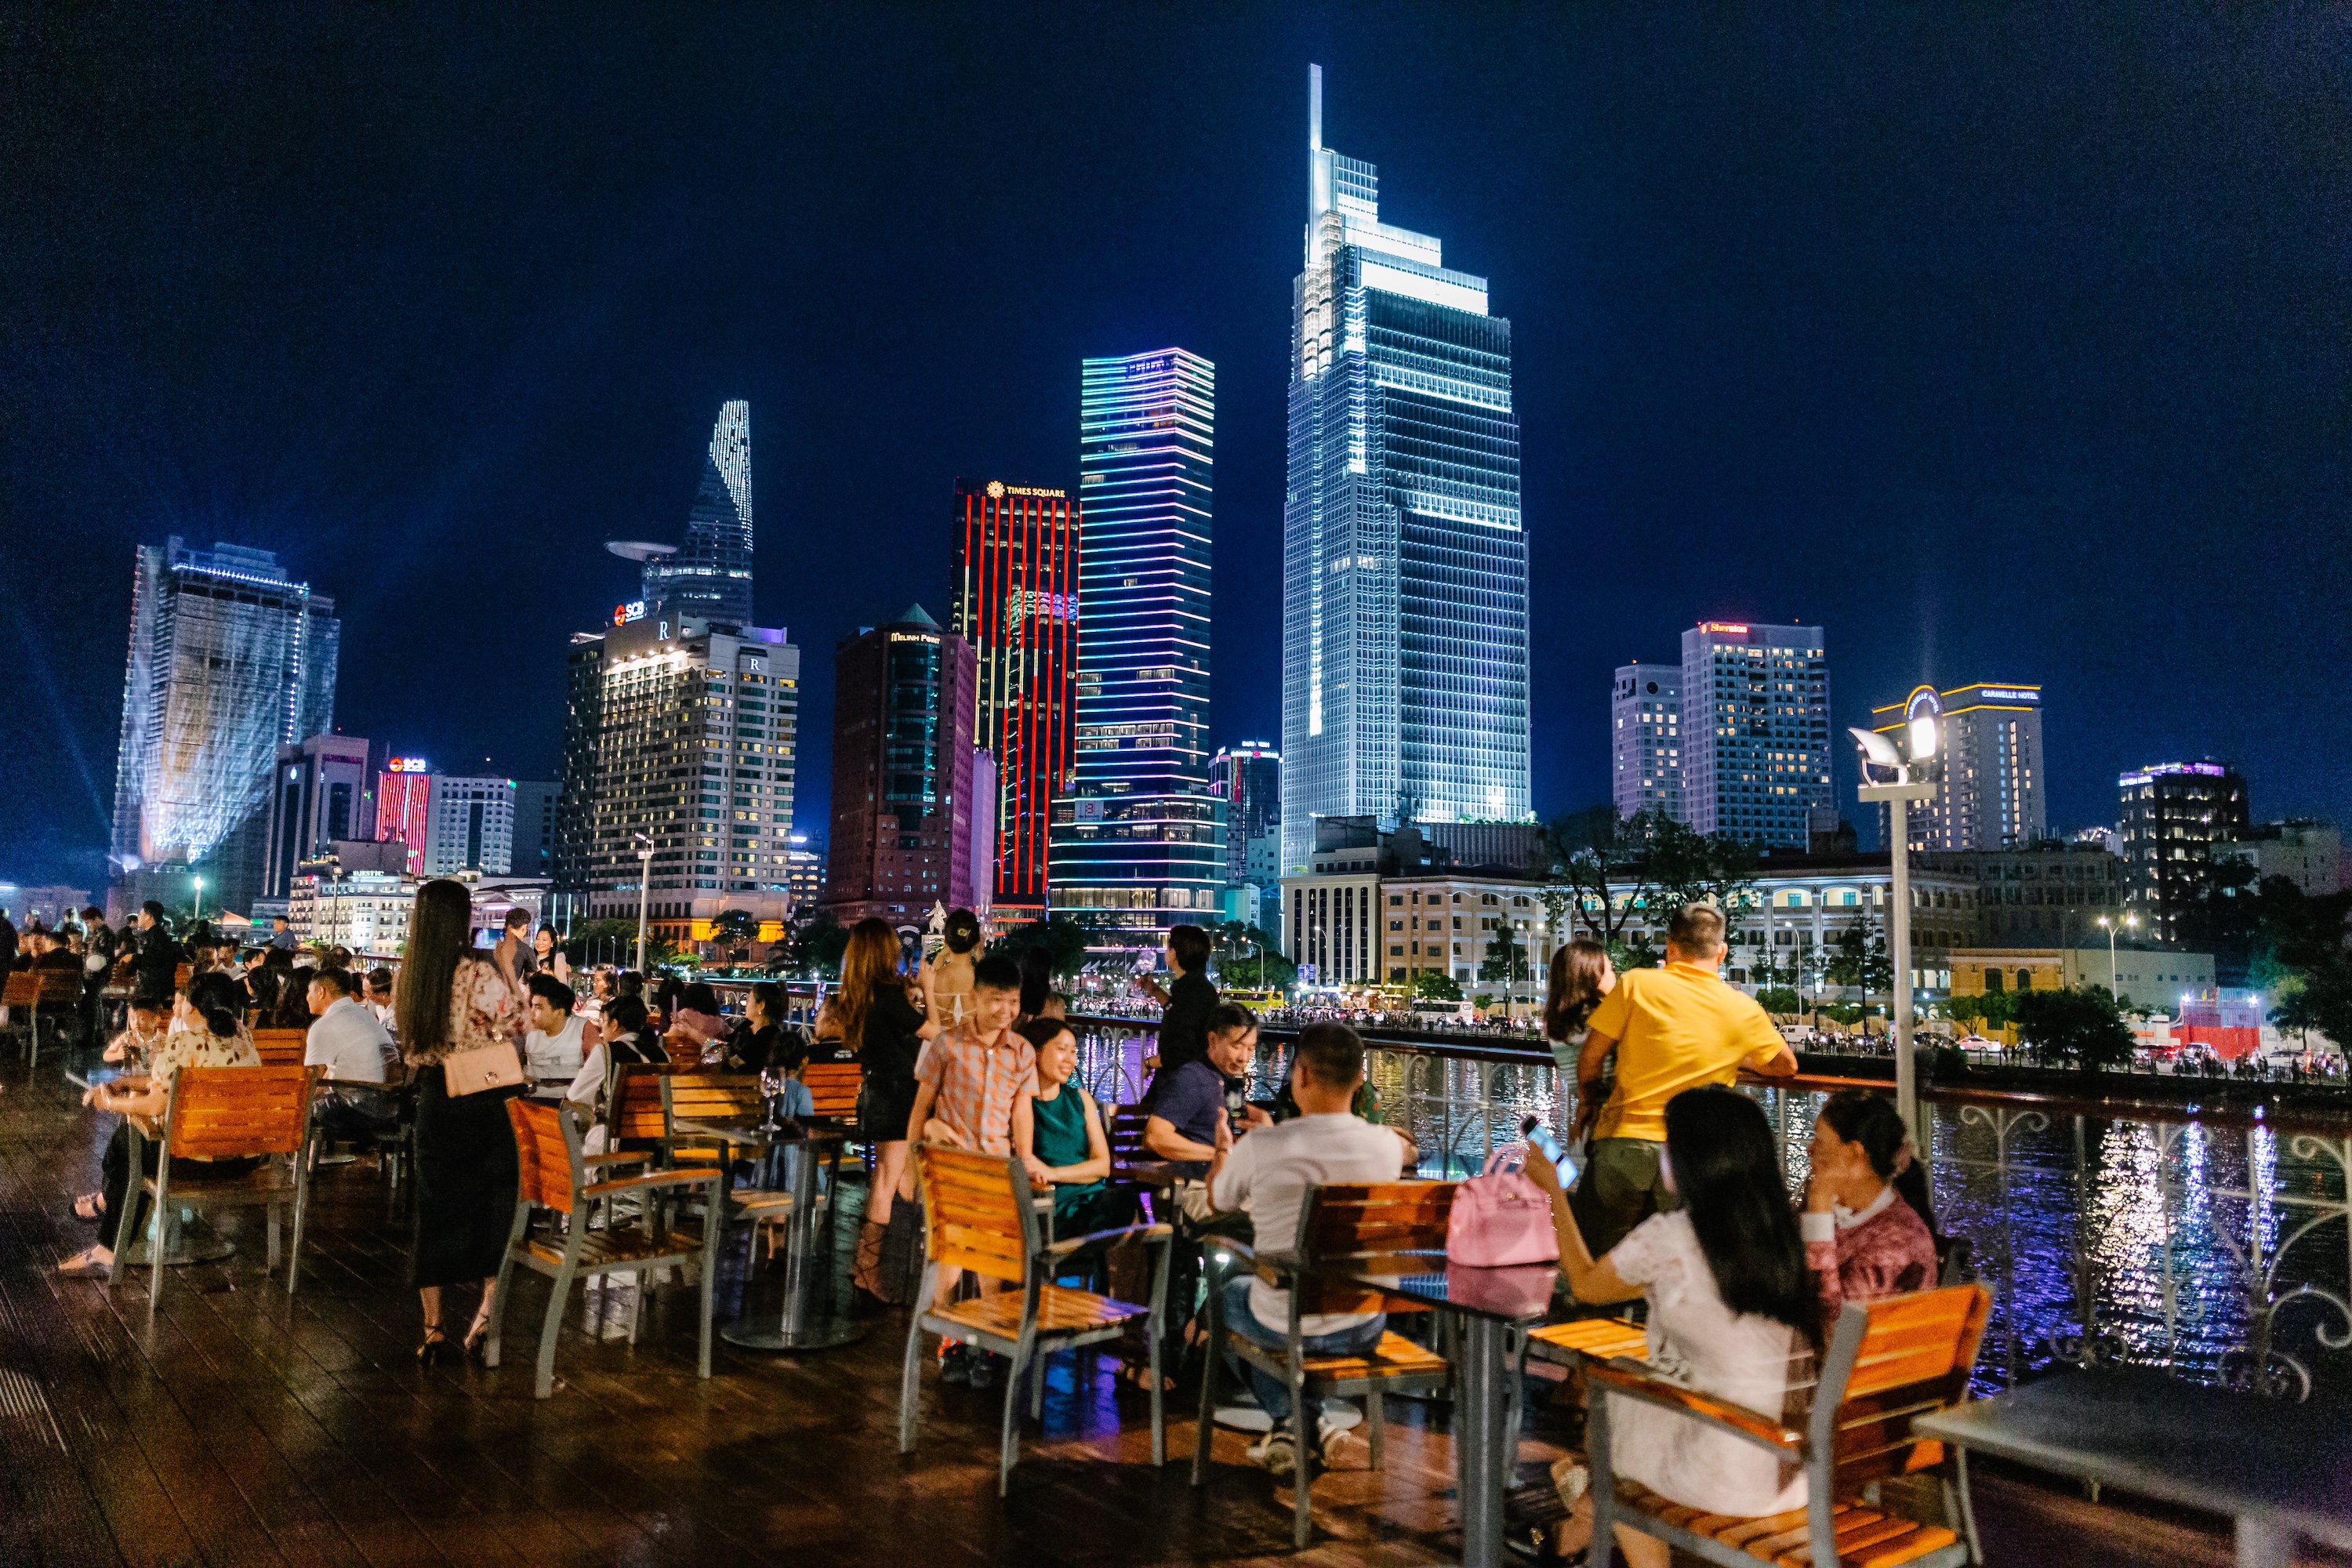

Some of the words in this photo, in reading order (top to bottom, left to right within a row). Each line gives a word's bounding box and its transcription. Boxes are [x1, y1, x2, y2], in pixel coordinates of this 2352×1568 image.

[1007, 486, 1032, 495] TIMES
[1032, 488, 1065, 498] SQUARE
[626, 601, 644, 618] SCB
[659, 620, 670, 641] R
[1711, 622, 1748, 633] Sheraton
[750, 658, 760, 671] R
[1981, 690, 2017, 699] CARAVELLE
[2018, 691, 2039, 700] HOTEL
